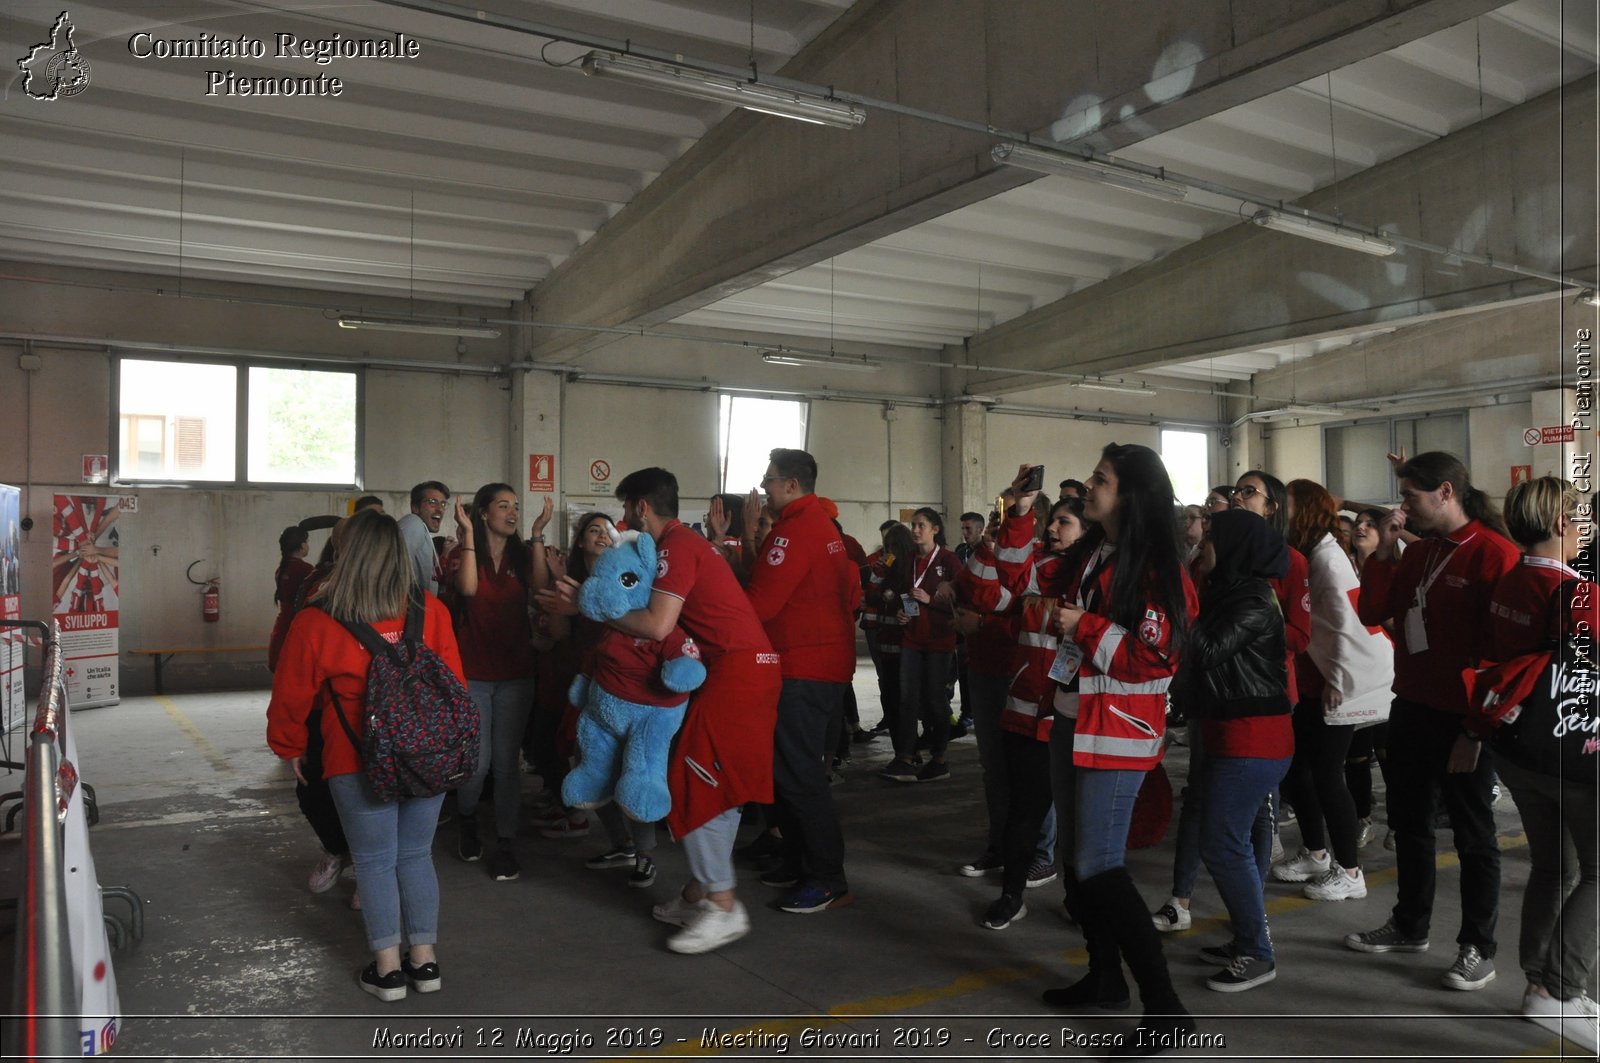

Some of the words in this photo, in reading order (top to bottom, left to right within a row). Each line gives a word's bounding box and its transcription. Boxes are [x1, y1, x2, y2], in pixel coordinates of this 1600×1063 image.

[1543, 426, 1573, 435] VIETATO
[1543, 434, 1573, 443] FUMARE
[65, 613, 108, 629] SVILUPPO
